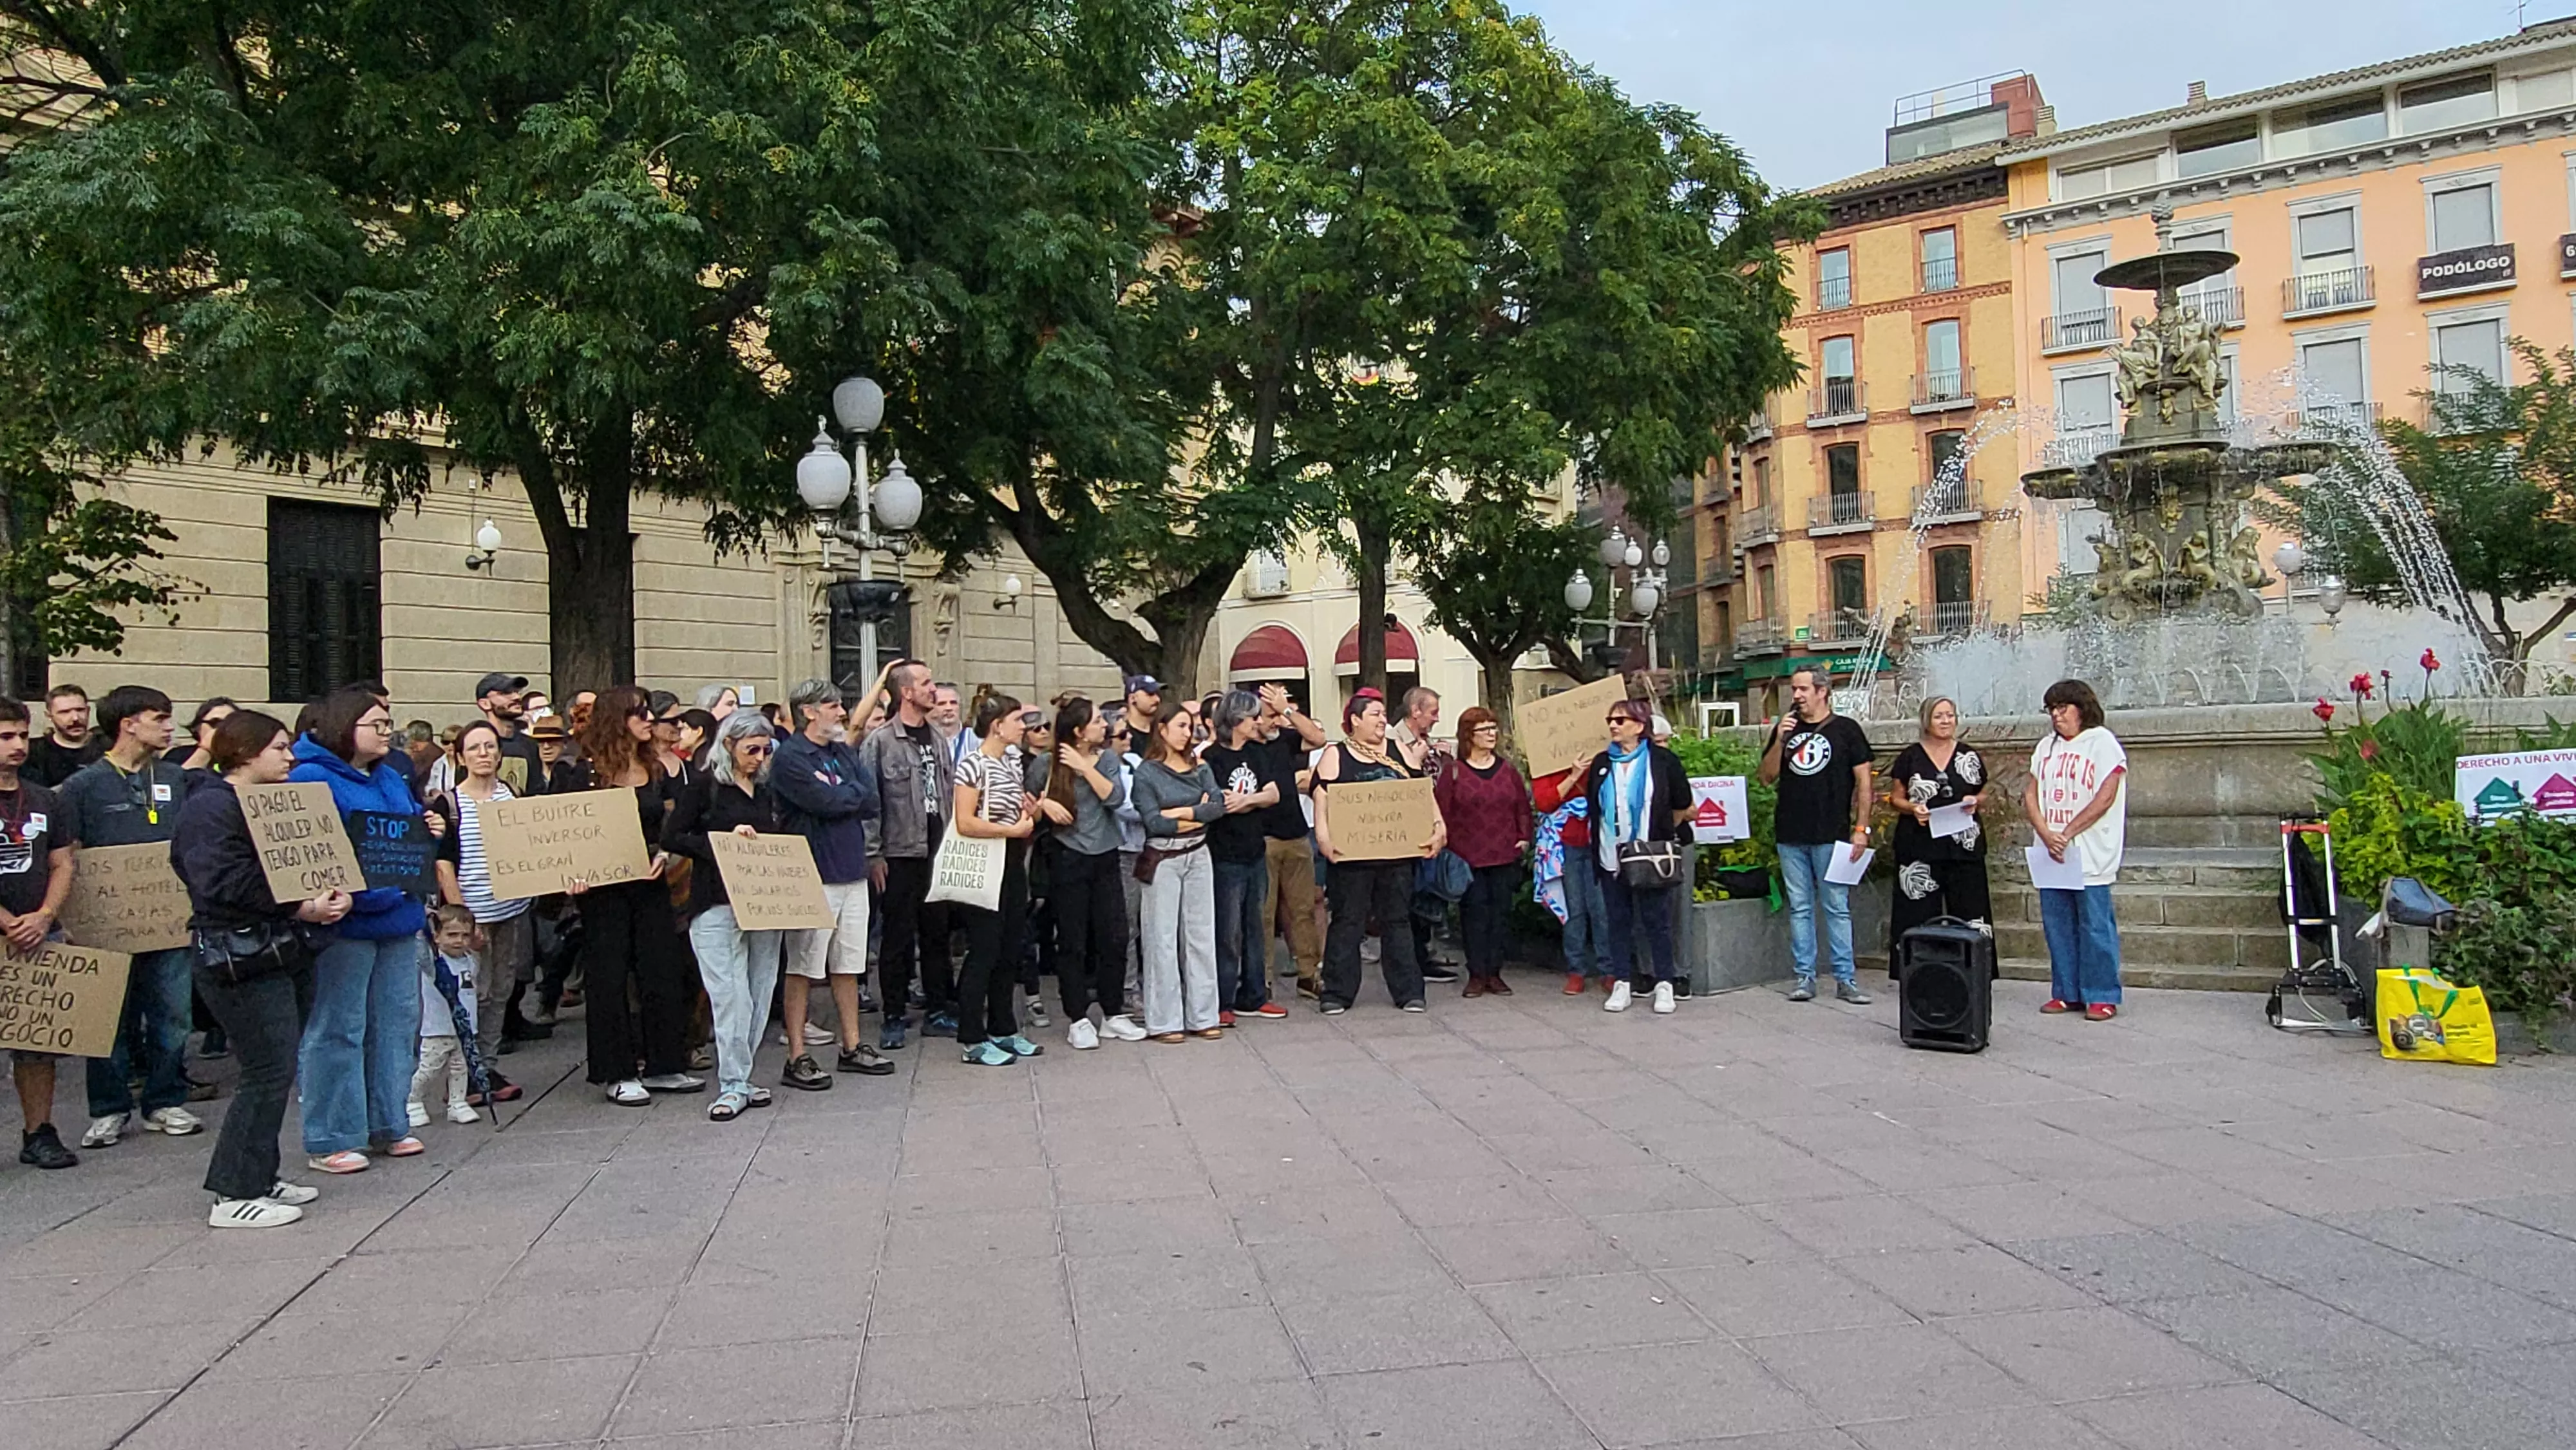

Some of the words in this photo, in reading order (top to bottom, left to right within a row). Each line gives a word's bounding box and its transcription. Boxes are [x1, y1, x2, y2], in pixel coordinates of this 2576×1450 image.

[2566, 244, 2576, 258] 6
[2422, 255, 2511, 279] PODÓLOGO
[2456, 757, 2510, 769] DERECHO
[2514, 757, 2521, 765] A
[2524, 754, 2551, 764] UNA
[247, 795, 260, 819] SI
[259, 791, 290, 816] PAGO
[289, 790, 307, 812] EL
[1336, 789, 1363, 804] SUS
[1367, 786, 1426, 803] NEGOCIOS
[366, 816, 410, 839] STOP
[497, 809, 526, 828] EL
[527, 824, 606, 847] INVERSOR
[263, 846, 301, 872] TENGO
[302, 842, 337, 865] PARA
[944, 840, 989, 858] RADICES
[495, 860, 515, 875] ES
[518, 860, 535, 872] EL
[538, 851, 573, 871] GRAN
[942, 855, 987, 873] RADICES
[131, 880, 185, 894] HOTEL
[940, 871, 984, 889] RADICES
[0, 966, 23, 981] ES
[31, 970, 58, 989] UN
[0, 985, 74, 1012] RECHO
[30, 1010, 55, 1026] UN
[0, 1022, 73, 1048] GOCIO
